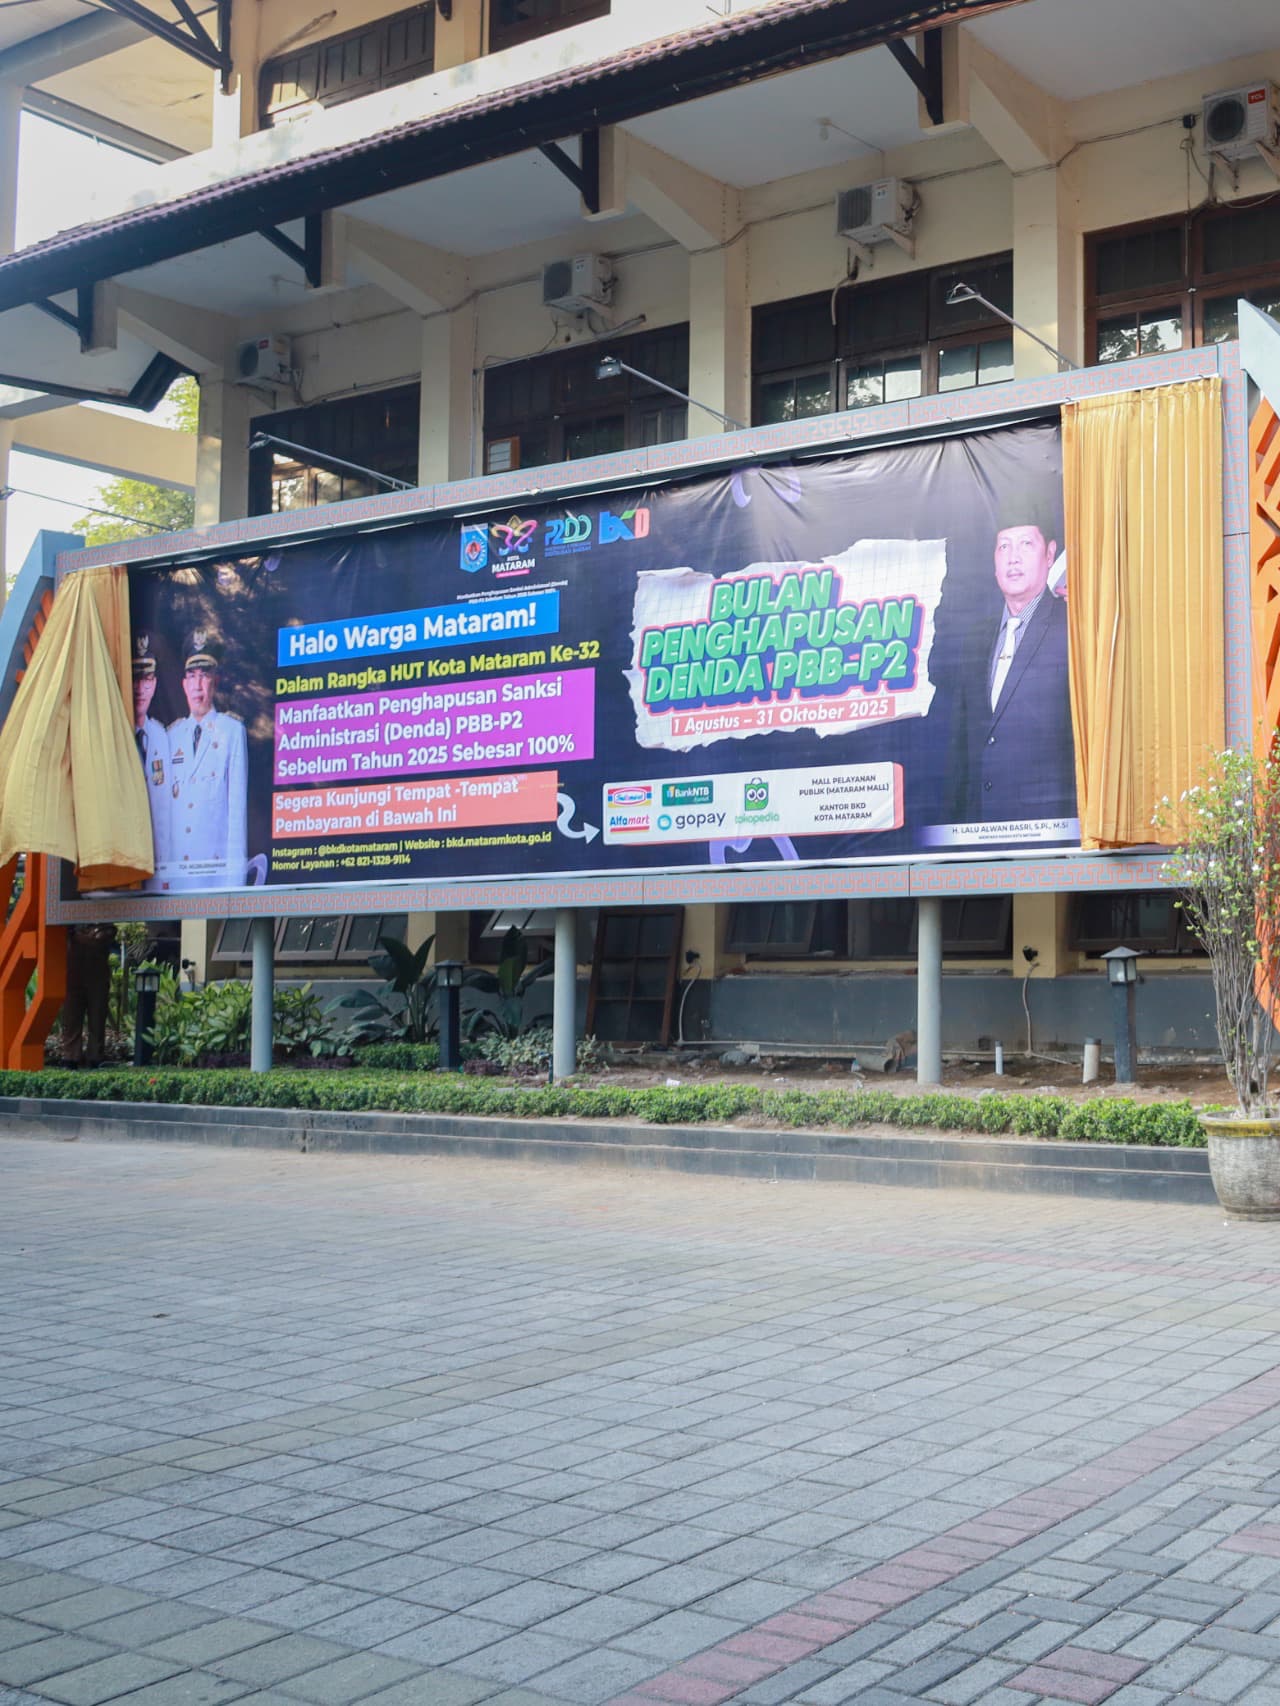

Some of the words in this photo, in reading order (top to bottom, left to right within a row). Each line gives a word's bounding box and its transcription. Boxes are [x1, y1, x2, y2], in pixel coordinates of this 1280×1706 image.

[491, 558, 536, 574] MATARAM
[710, 570, 834, 622] BULAN
[290, 630, 338, 657] Halo
[344, 623, 417, 650] Warga
[423, 602, 536, 640] Mataram!
[641, 599, 915, 668] PENGHAPUSAN
[276, 675, 324, 695] Dalam
[328, 667, 387, 690] Rangka
[390, 661, 424, 682] HUT
[428, 658, 466, 677] Kota
[470, 650, 546, 673] Mataram
[551, 640, 600, 664] Ke-32
[645, 655, 765, 704] DENDA
[772, 639, 910, 690] PBB-P2
[279, 700, 375, 726] Manfaatkan
[379, 688, 497, 716] Penghapusan
[502, 675, 562, 702] Sanksi
[278, 723, 379, 751] Administrasi
[384, 717, 451, 745] (Denda)
[456, 710, 523, 735] PBB-P2
[673, 718, 680, 733] 1
[684, 714, 740, 736] Agustus
[756, 710, 774, 726] 31
[780, 705, 843, 724] Oktober
[850, 699, 889, 718] 2025
[278, 756, 347, 777] Sebelum
[352, 751, 403, 771] Tahun
[407, 745, 448, 766] 2025
[452, 742, 523, 762] Sebesar
[527, 734, 575, 756] 100%
[799, 788, 824, 796] PUBLIK
[826, 785, 865, 796] (MATARAM
[866, 783, 889, 792] MALL)
[812, 778, 831, 786] MALL
[833, 774, 876, 785] PELAYANAN
[275, 794, 322, 812] Segera
[326, 786, 391, 808] Kunjungi
[395, 784, 451, 803] Tempat
[455, 778, 519, 798] -Tempat
[819, 803, 848, 811] KANTOR
[275, 814, 361, 833] Pembayaran
[365, 810, 379, 827] di
[383, 807, 433, 826] Bawah
[438, 804, 457, 823] Ini
[609, 814, 650, 827] Alfamart
[675, 811, 727, 830] gopay
[735, 812, 780, 825] tokopedia
[814, 813, 834, 821] KOTA
[835, 811, 872, 821] MATARAM
[961, 825, 979, 834] LALU
[981, 823, 1008, 833] ALWAN
[272, 847, 312, 859] Instagram
[318, 842, 398, 857] @bkdkotamataram
[404, 838, 440, 850] Website
[446, 832, 552, 849] bkd.mataramkota.go.id
[271, 861, 299, 871] Nomor
[301, 859, 335, 871] Layanan
[340, 857, 355, 867] +62
